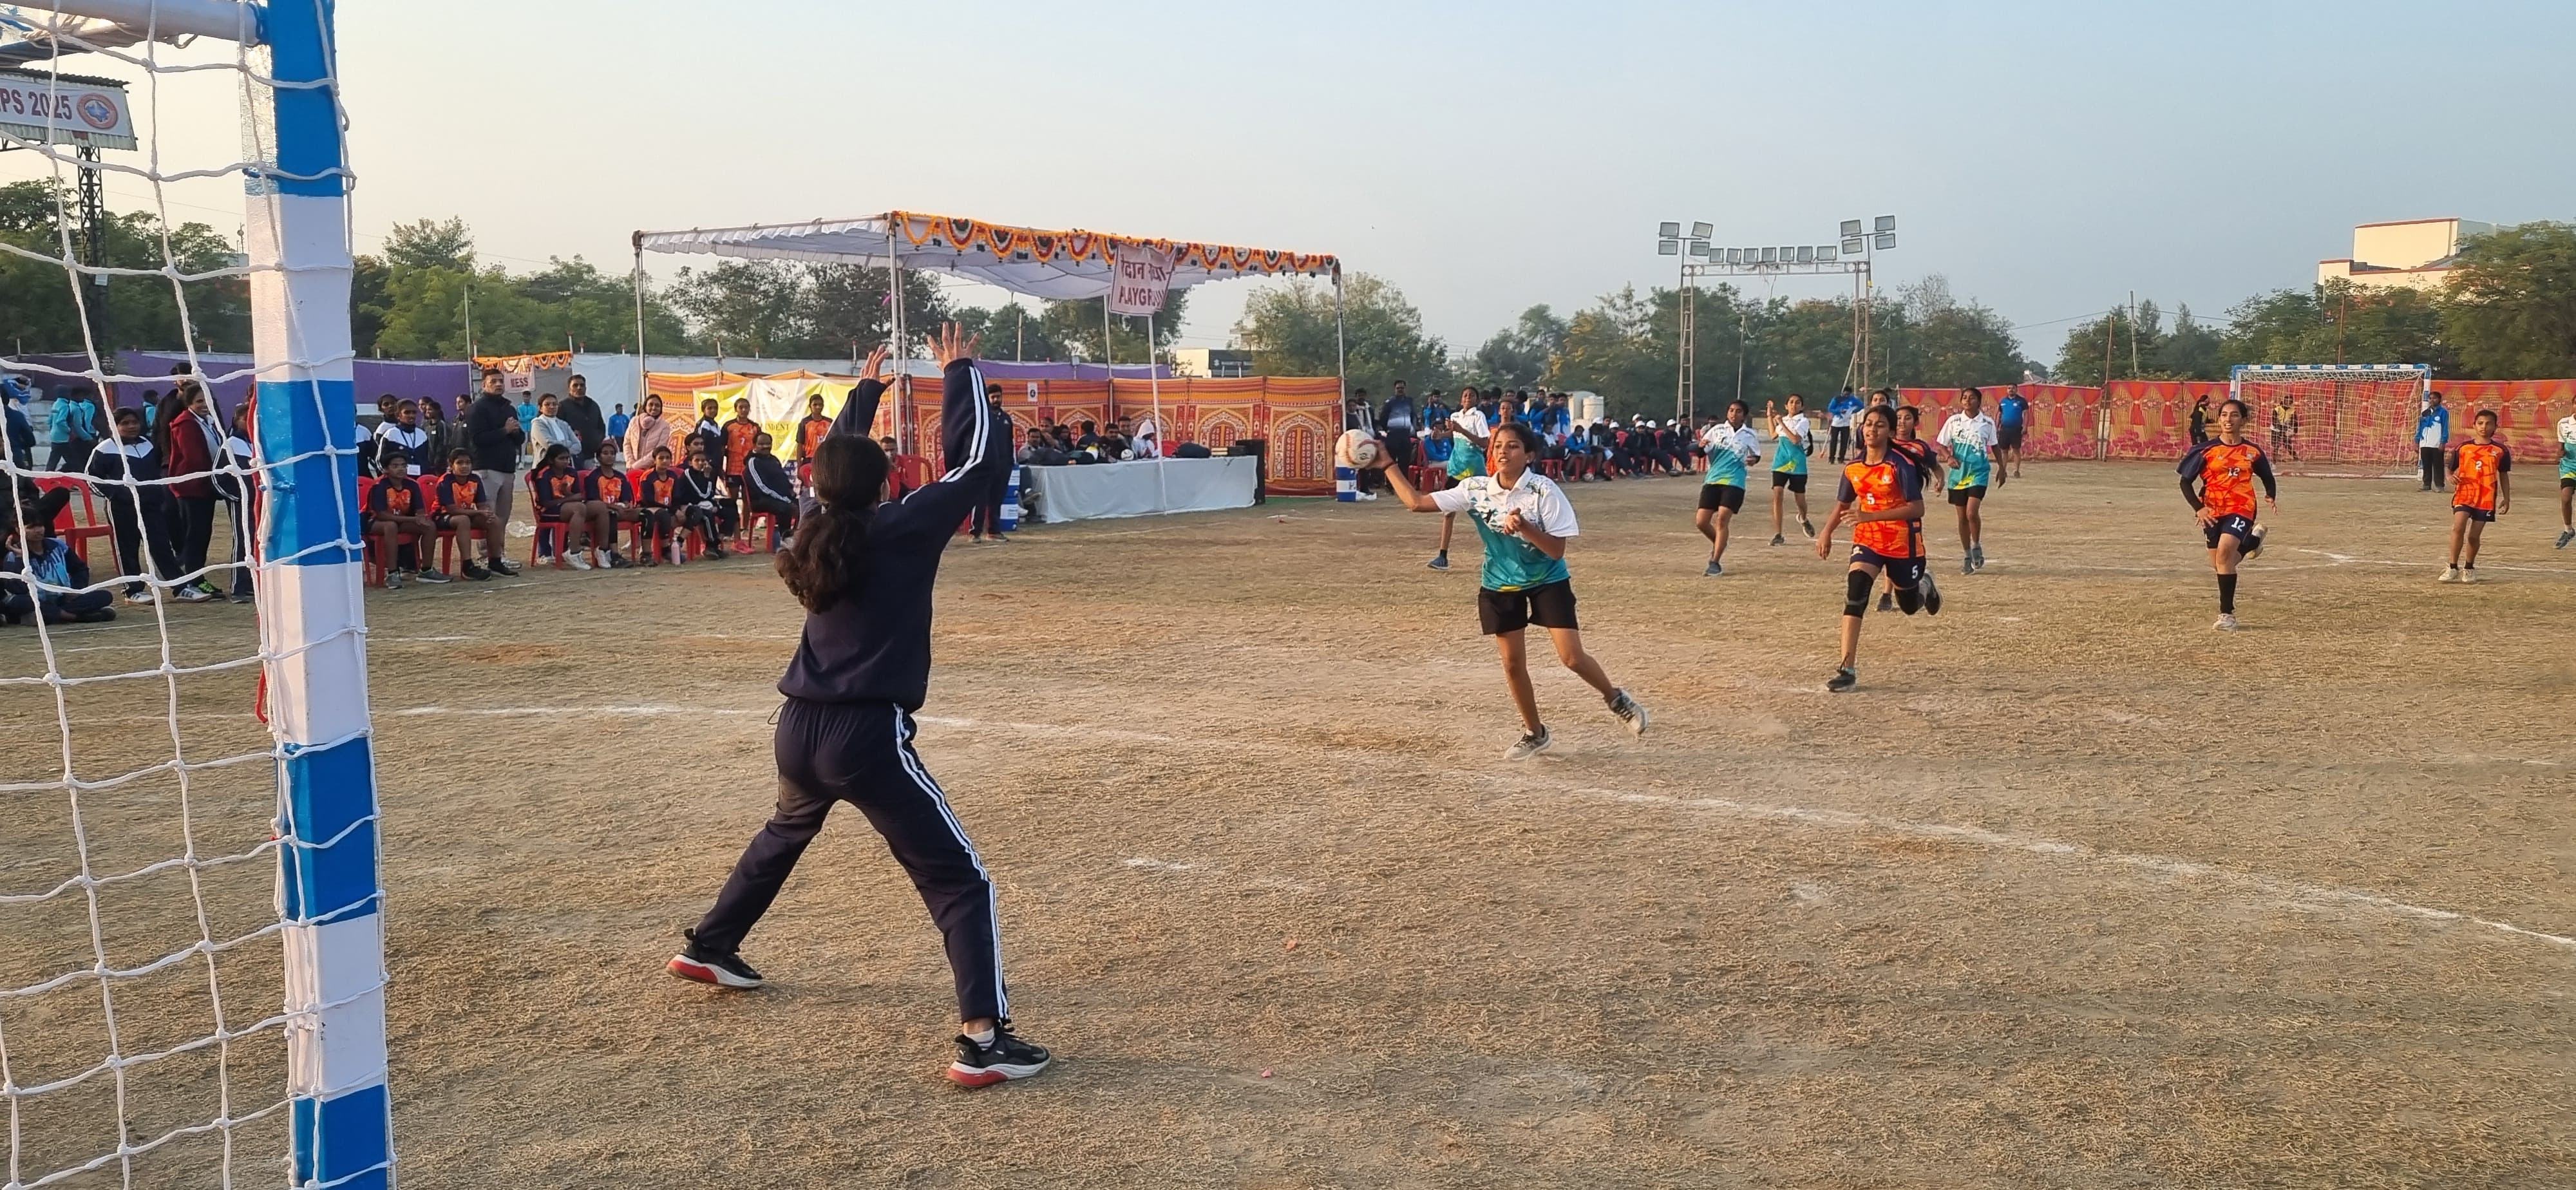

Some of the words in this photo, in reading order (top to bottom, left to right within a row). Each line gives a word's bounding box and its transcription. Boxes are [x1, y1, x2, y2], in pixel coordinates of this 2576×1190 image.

[0, 88, 24, 115] PS
[28, 91, 73, 120] 2025
[2476, 460, 2482, 470] 2
[2228, 467, 2240, 477] 12
[1866, 493, 1875, 505] 5
[2231, 516, 2246, 532] 12
[1912, 565, 1918, 579] 5
